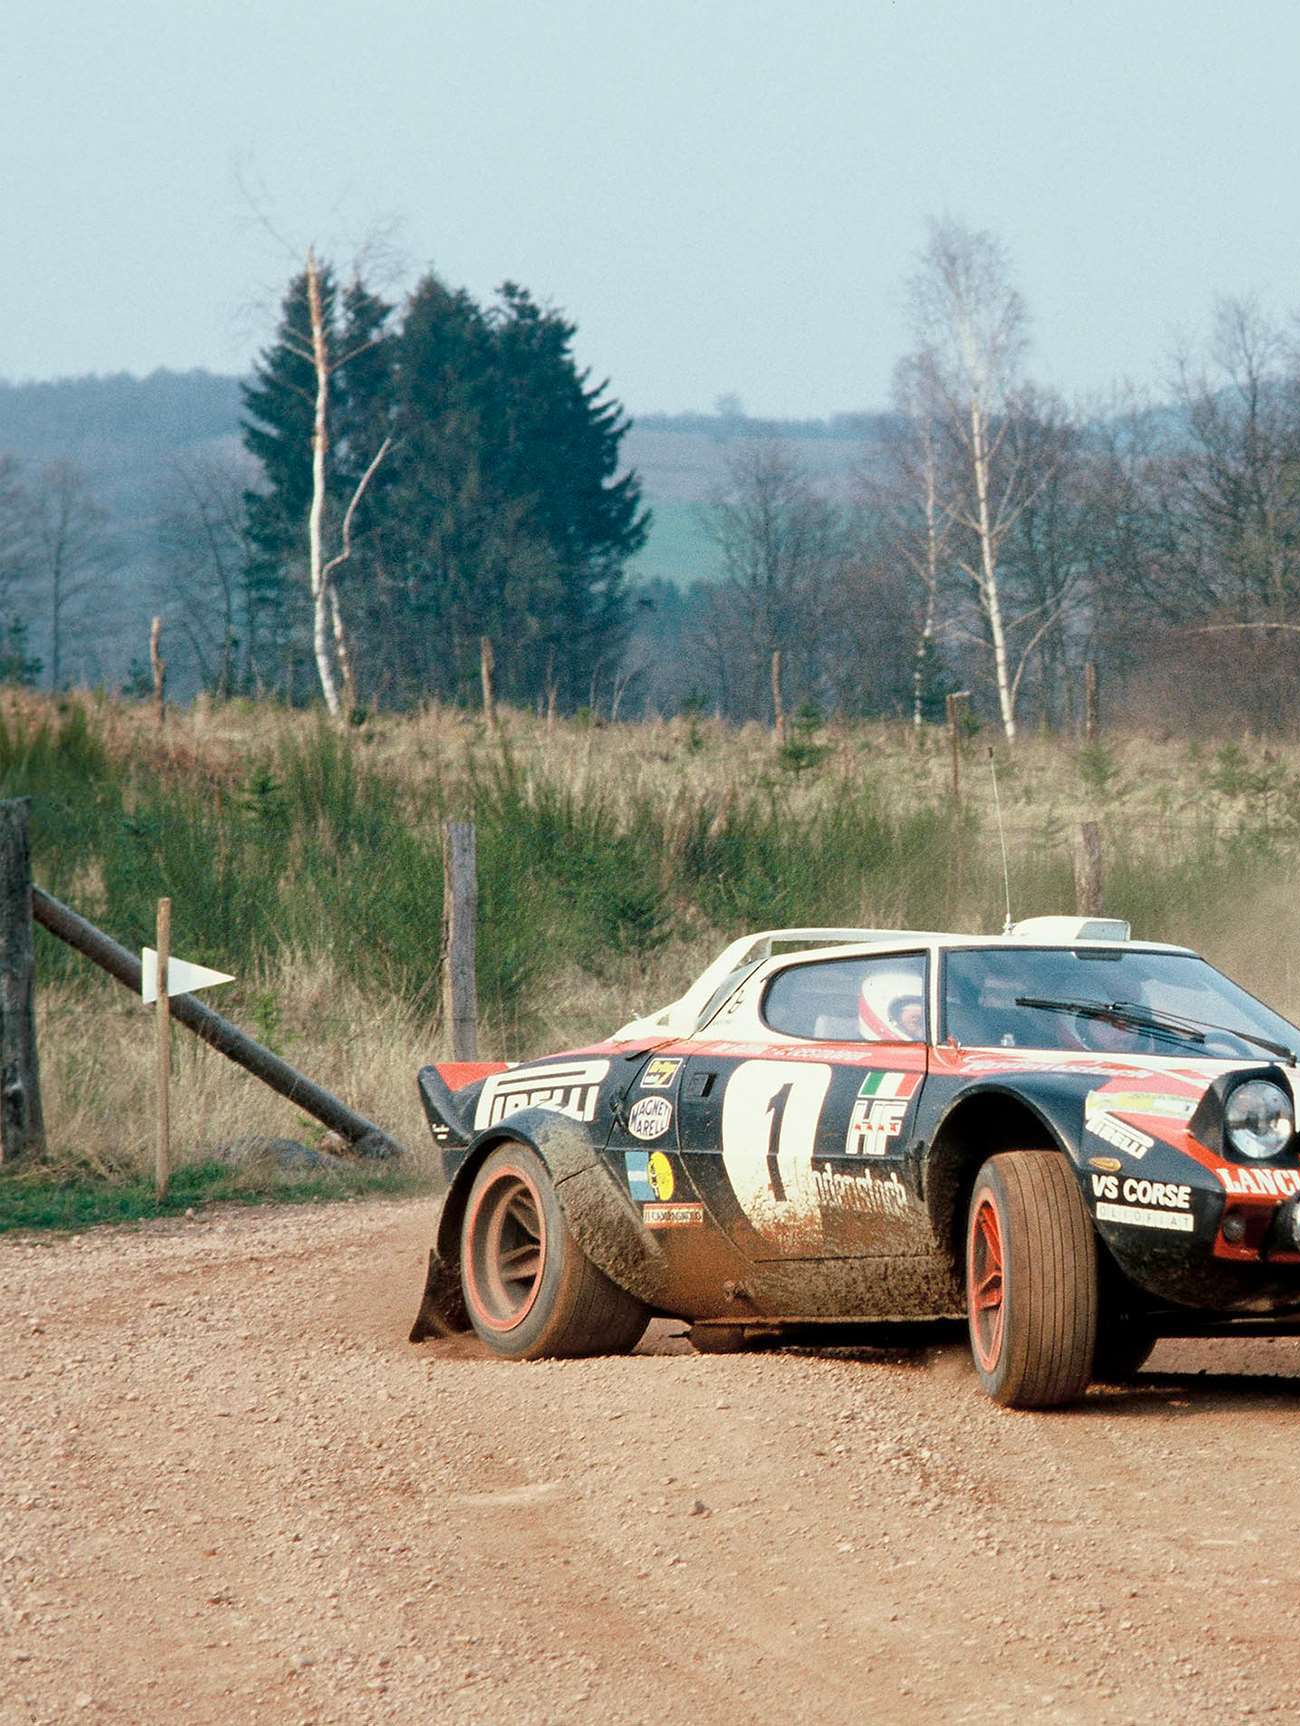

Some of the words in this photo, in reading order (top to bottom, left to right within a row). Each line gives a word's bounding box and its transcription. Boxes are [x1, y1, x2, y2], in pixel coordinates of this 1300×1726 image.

[474, 1060, 610, 1131] PIRELLI
[766, 1083, 795, 1201] 1
[846, 1101, 907, 1155] HF
[1085, 1113, 1154, 1160] PIRELLI
[1091, 1174, 1119, 1199] VS
[1123, 1178, 1191, 1209] CORSE
